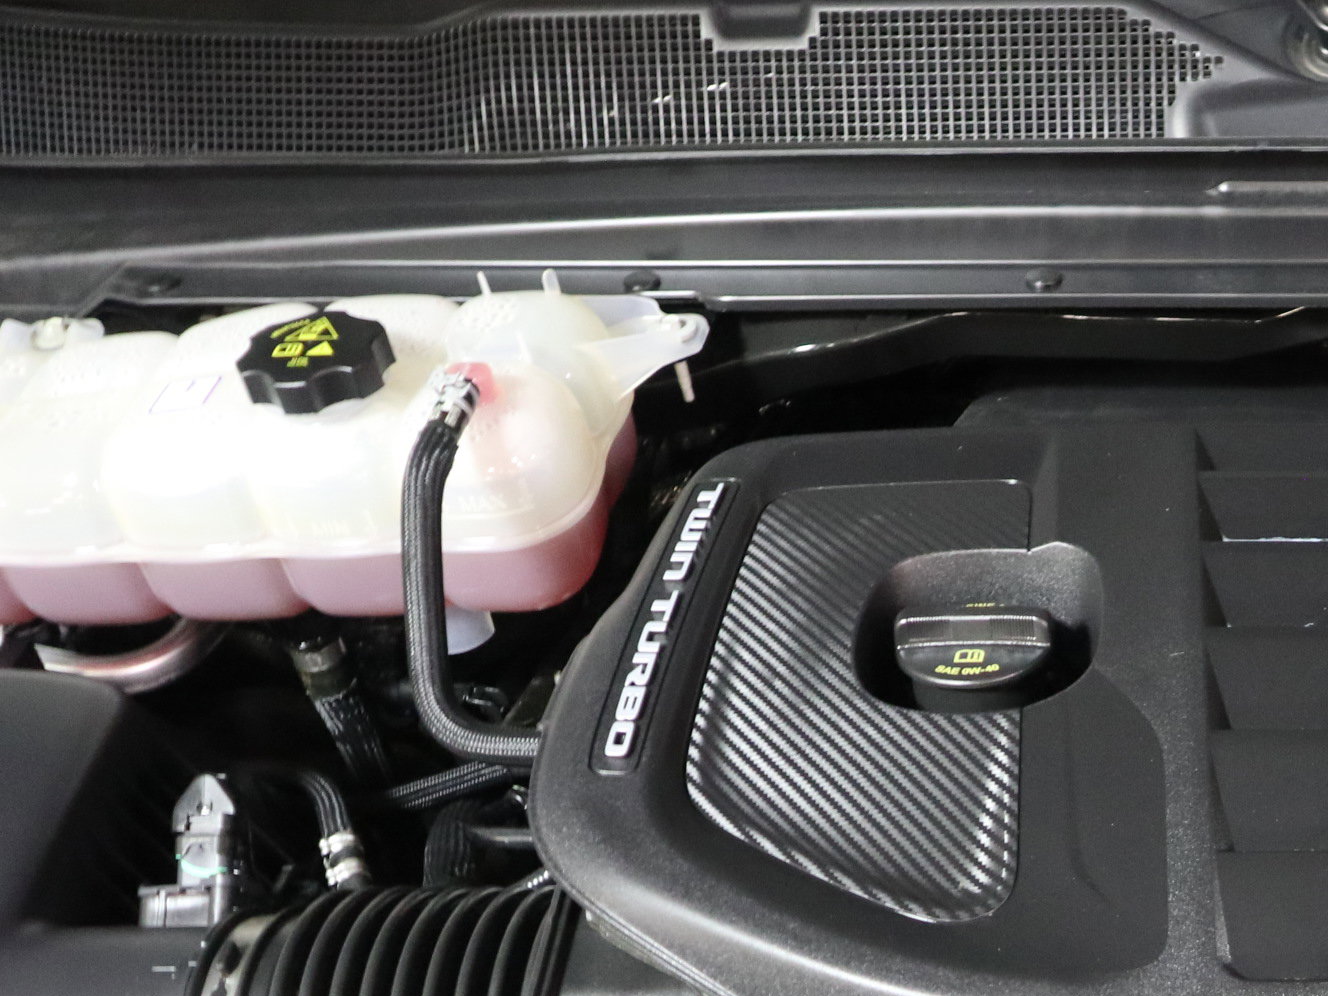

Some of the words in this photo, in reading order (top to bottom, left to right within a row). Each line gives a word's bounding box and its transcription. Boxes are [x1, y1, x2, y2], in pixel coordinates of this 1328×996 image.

[662, 482, 725, 581] TWIN
[604, 589, 680, 757] TURBO
[934, 664, 959, 675] SAE
[961, 663, 1000, 675] 0W-40
